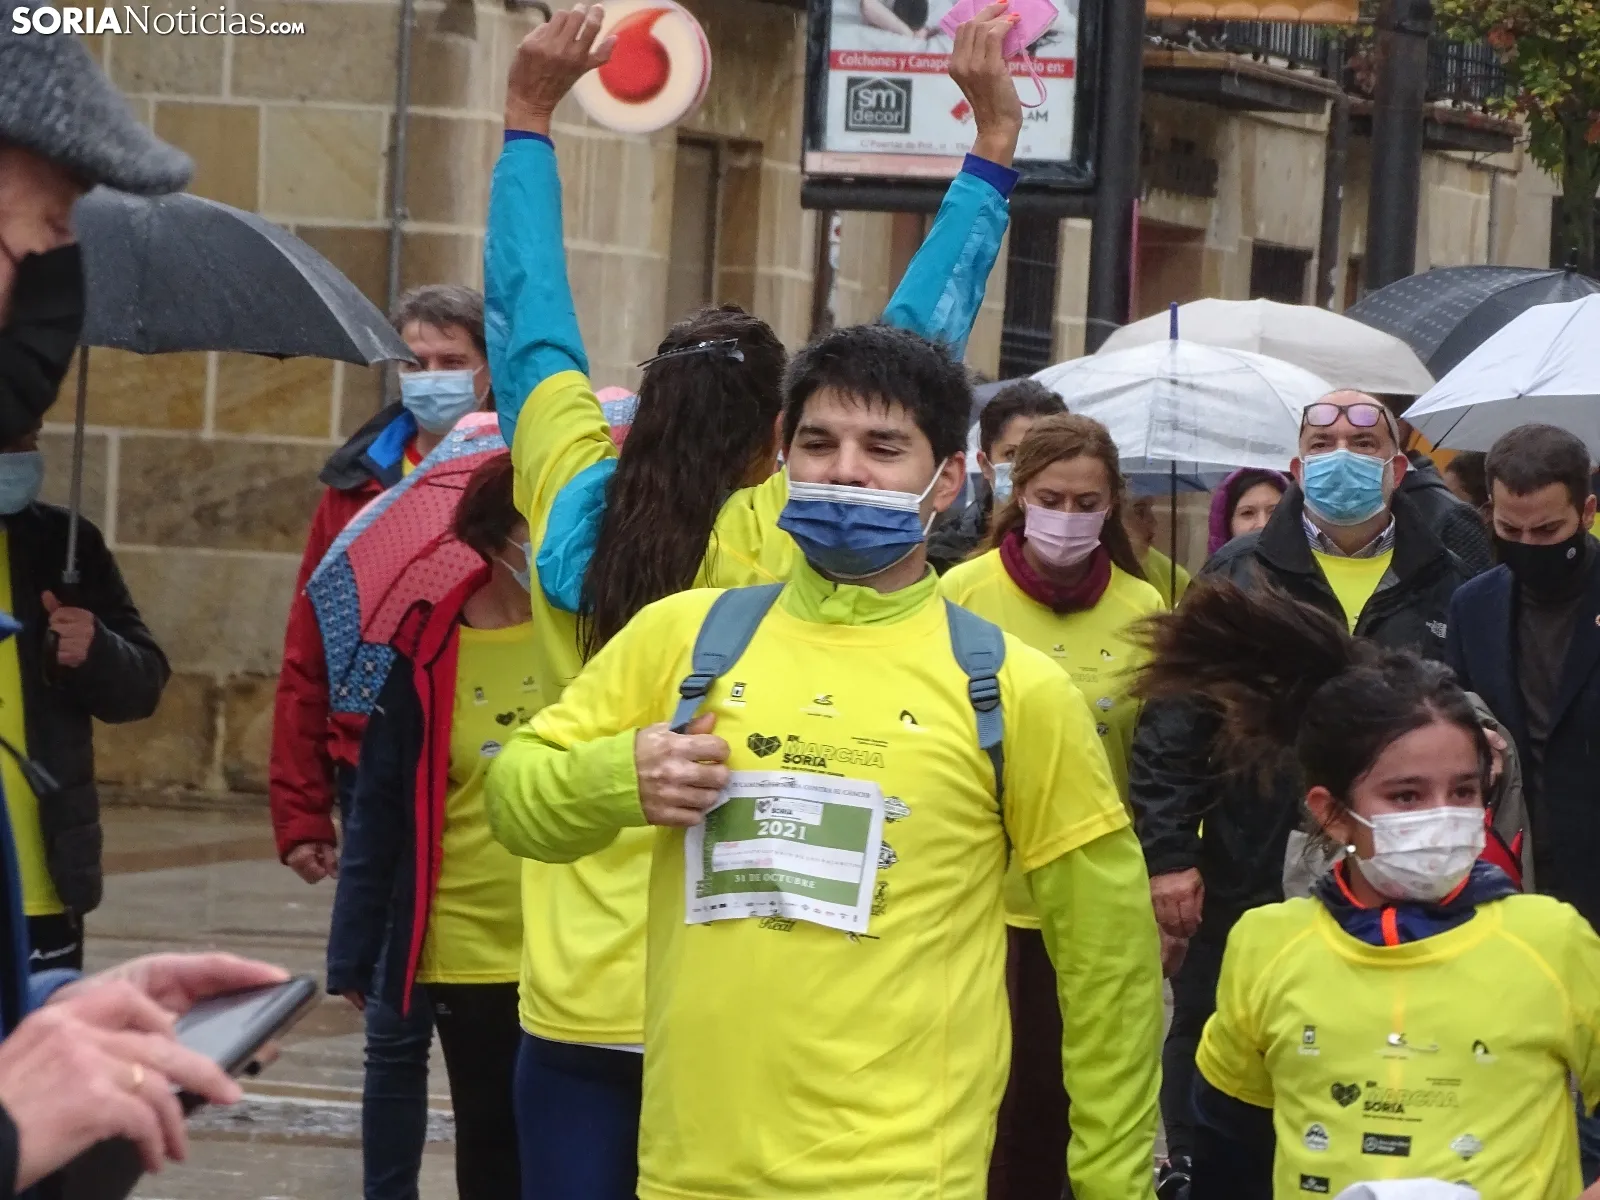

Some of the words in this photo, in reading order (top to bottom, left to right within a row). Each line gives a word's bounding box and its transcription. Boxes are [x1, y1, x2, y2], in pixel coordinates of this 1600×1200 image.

[838, 53, 897, 66] Colchones
[898, 59, 906, 69] y
[1047, 63, 1065, 73] en:
[858, 88, 897, 109] sm
[854, 109, 901, 123] decor
[782, 753, 827, 769] SORIA
[785, 741, 885, 769] MARCHA
[757, 820, 807, 841] 2021
[734, 874, 746, 883] 31
[749, 873, 762, 882] DE
[763, 872, 817, 889] OCTUBRE
[1363, 1101, 1406, 1113] SORIA
